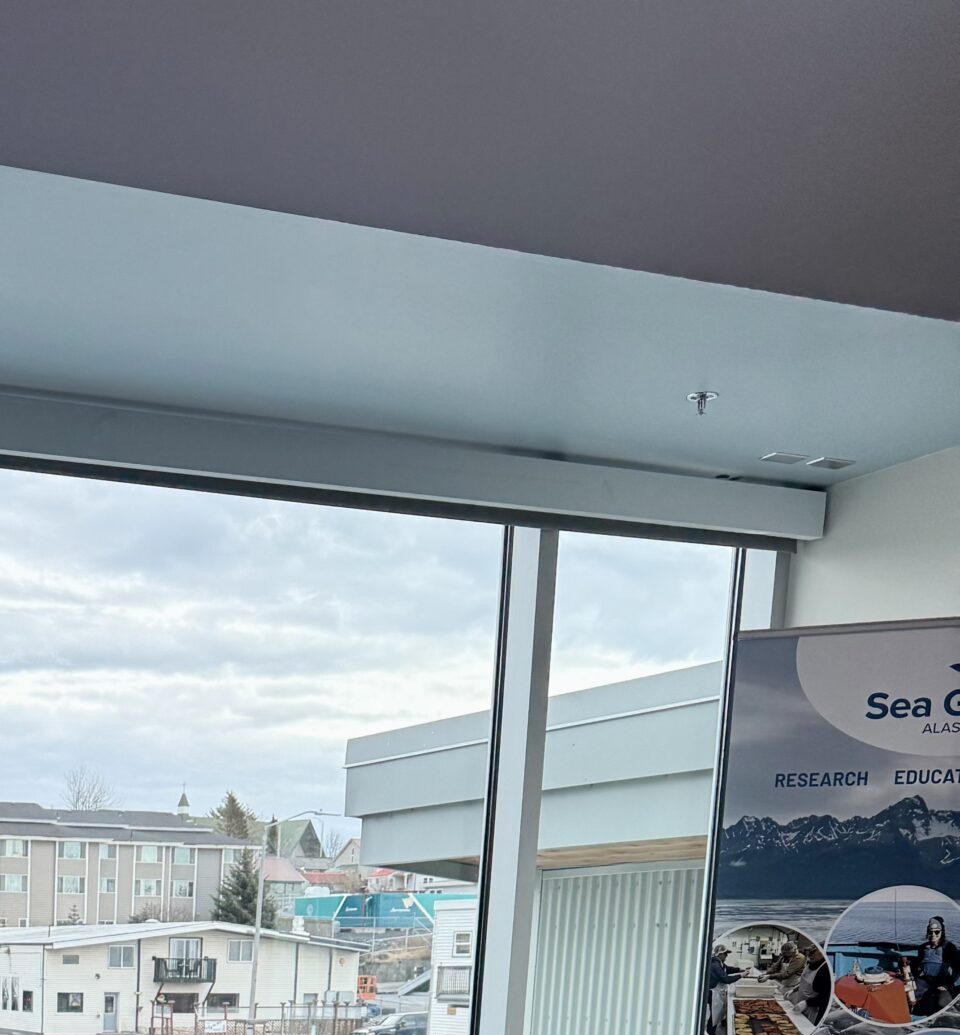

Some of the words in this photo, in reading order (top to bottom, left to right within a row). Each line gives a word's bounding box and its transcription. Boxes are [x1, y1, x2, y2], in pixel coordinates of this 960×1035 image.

[865, 692, 932, 720] Sea
[922, 722, 960, 734] ALAS
[774, 770, 869, 789] RESEARCH
